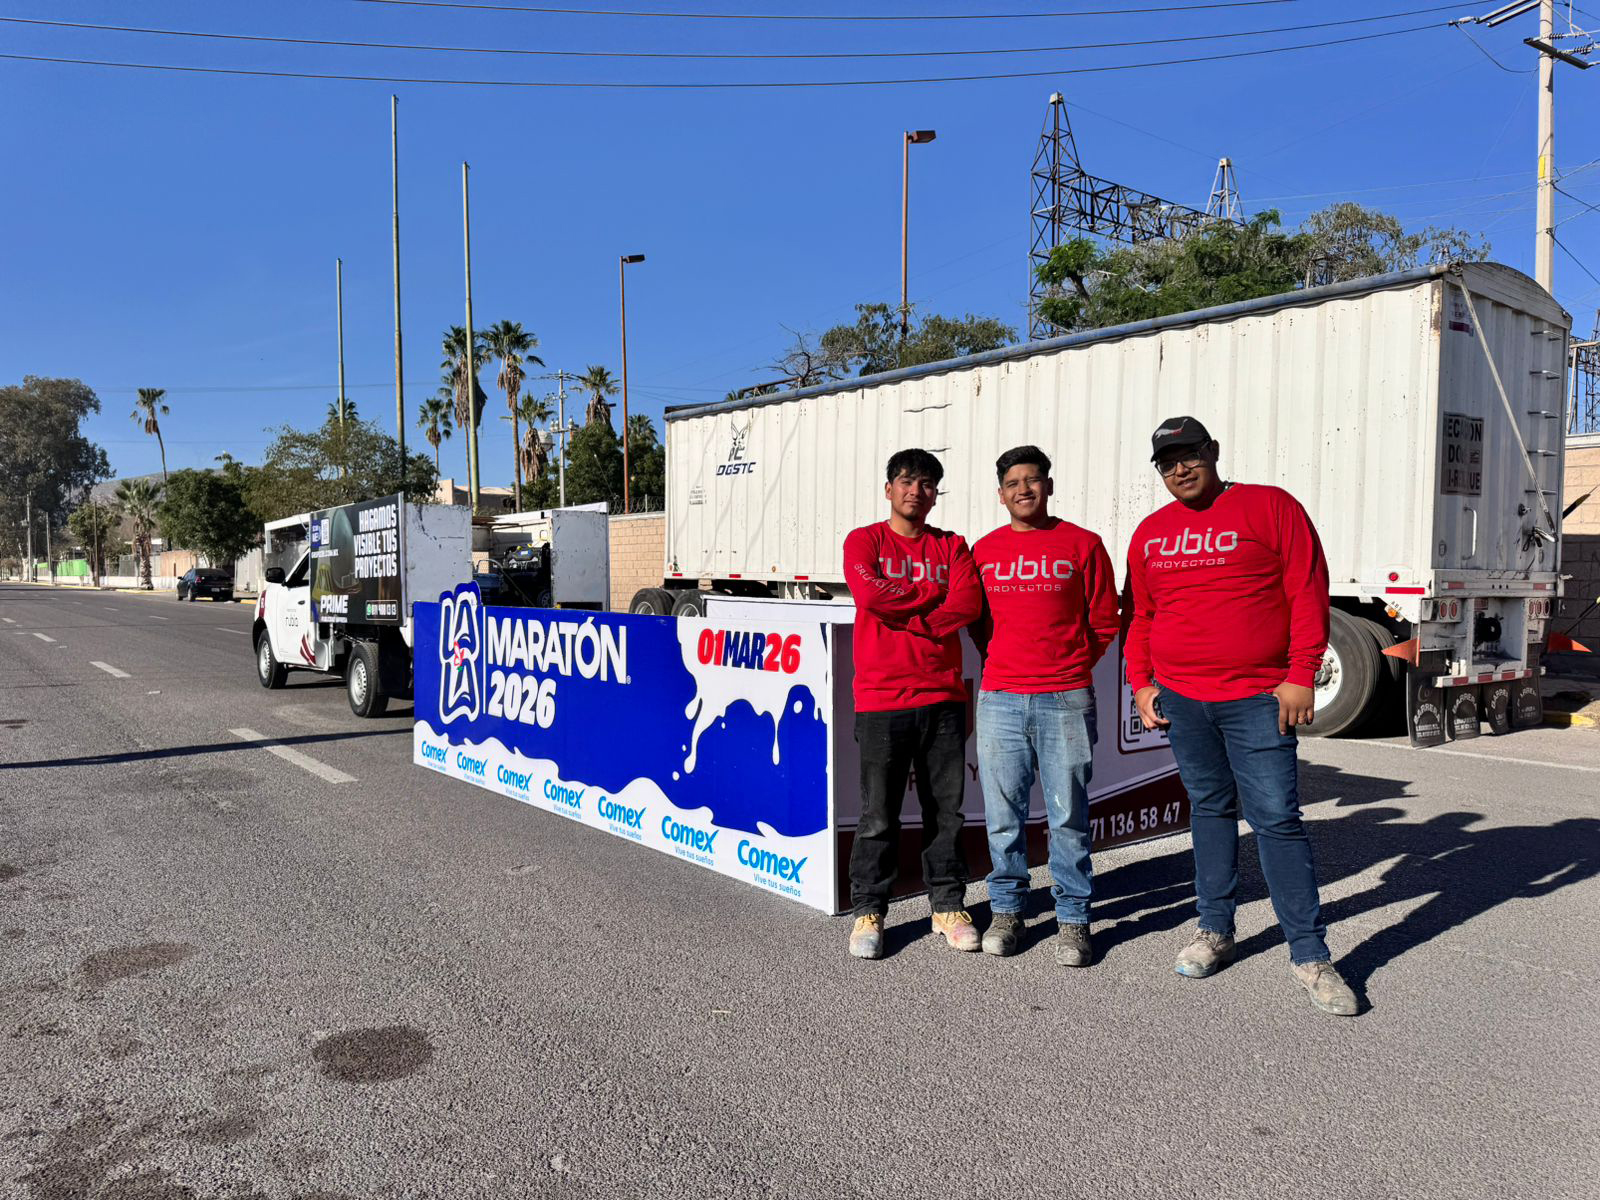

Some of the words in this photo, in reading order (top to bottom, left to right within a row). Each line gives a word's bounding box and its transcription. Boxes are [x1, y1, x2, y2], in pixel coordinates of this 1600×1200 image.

[716, 462, 756, 475] DGSTC
[359, 504, 397, 532] HAGAMOS
[354, 531, 381, 556] VISIBLE
[382, 529, 397, 554] TUS
[1144, 527, 1239, 559] rubio
[355, 553, 397, 578] PROYECTOS
[981, 555, 1073, 580] rubio
[1151, 557, 1226, 569] PROYECTOS
[987, 584, 1062, 593] PROYECTOS
[320, 595, 349, 614] PRIME
[488, 616, 628, 684] MARATÓN
[488, 670, 557, 729] 2026
[421, 740, 448, 763] Comex
[457, 752, 488, 776] Comex
[497, 764, 533, 791] Comex
[544, 779, 585, 808] Comex
[598, 796, 647, 829] Comex
[1090, 817, 1105, 842] 71
[1110, 811, 1135, 837] 136
[1140, 806, 1158, 830] 58
[1163, 801, 1180, 824] 47
[661, 816, 719, 853] Comex
[675, 846, 686, 856] Vive
[687, 850, 695, 859] tus
[737, 840, 808, 883] Comex
[754, 873, 767, 885] Vive
[768, 877, 778, 889] tus
[779, 882, 801, 897] sueños
